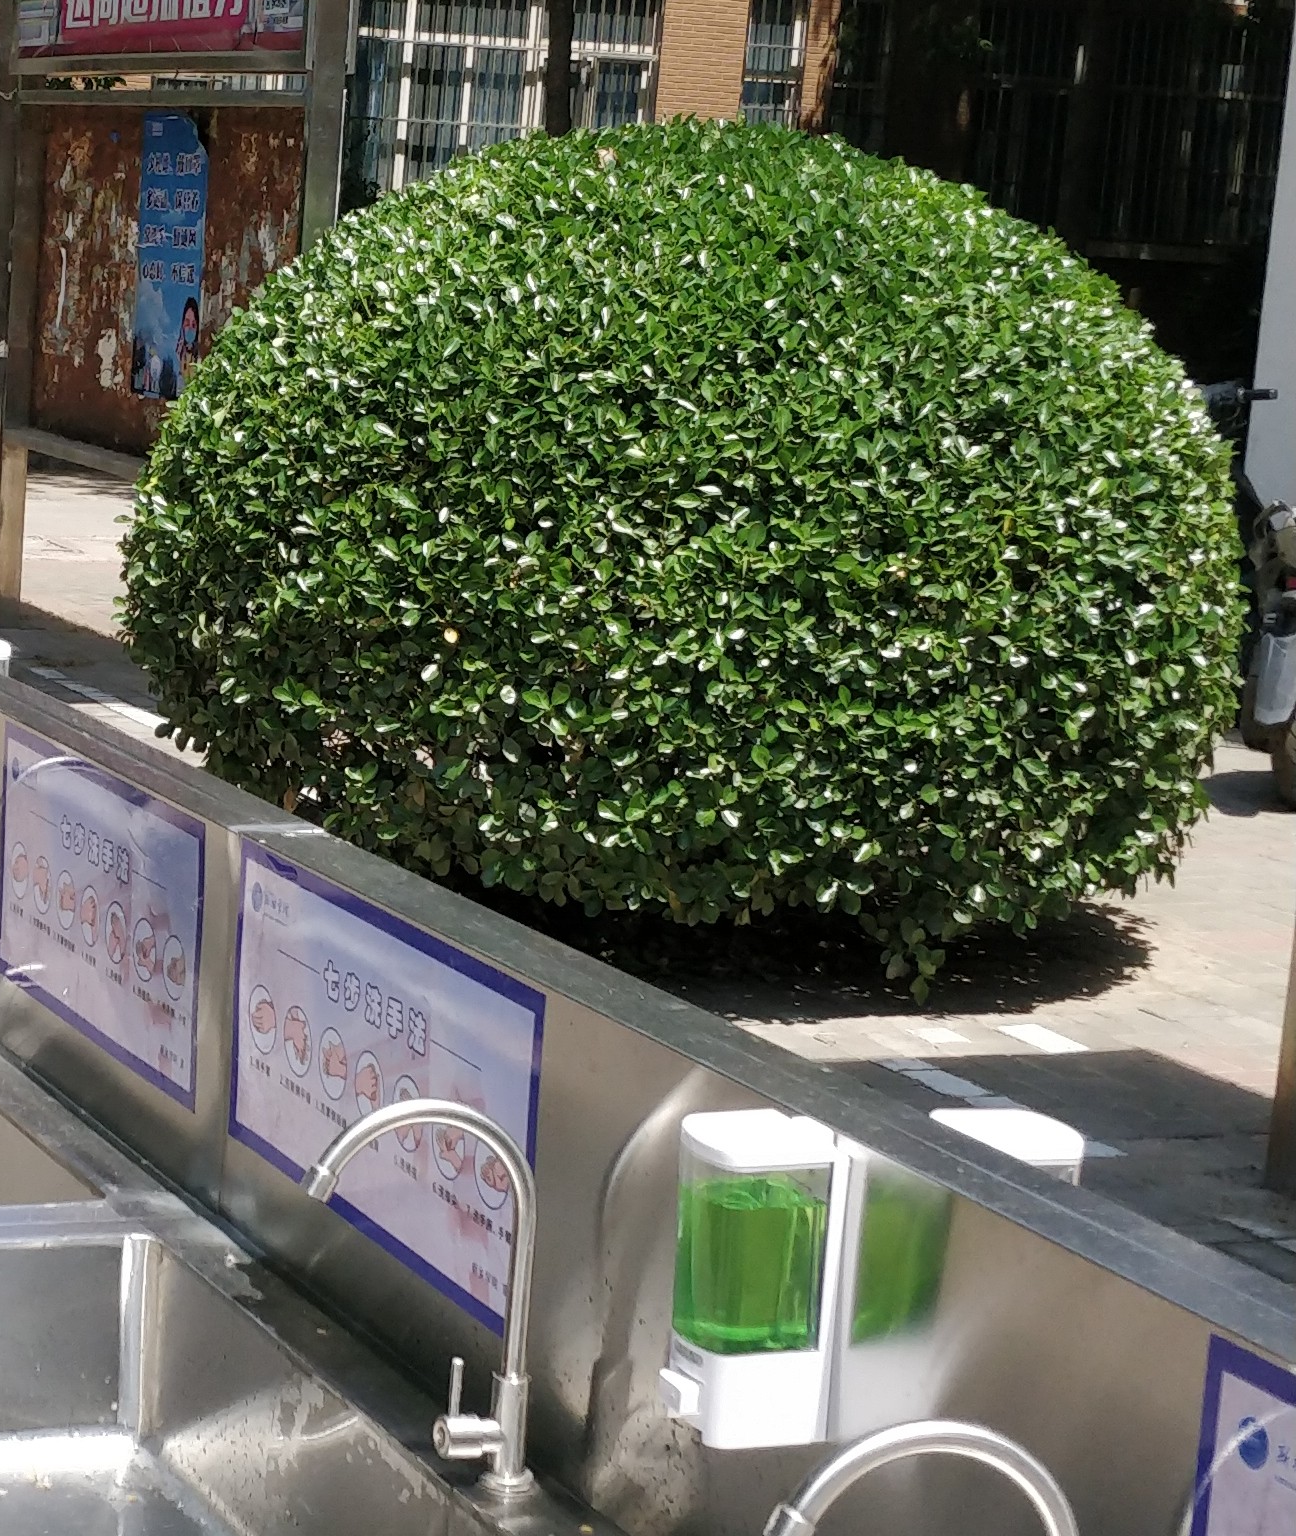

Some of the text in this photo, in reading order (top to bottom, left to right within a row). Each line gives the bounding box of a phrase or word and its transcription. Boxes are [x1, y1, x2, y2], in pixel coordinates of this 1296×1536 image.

[59, 813, 130, 885] 七步洗手法
[322, 959, 428, 1056] 七步洗手法
